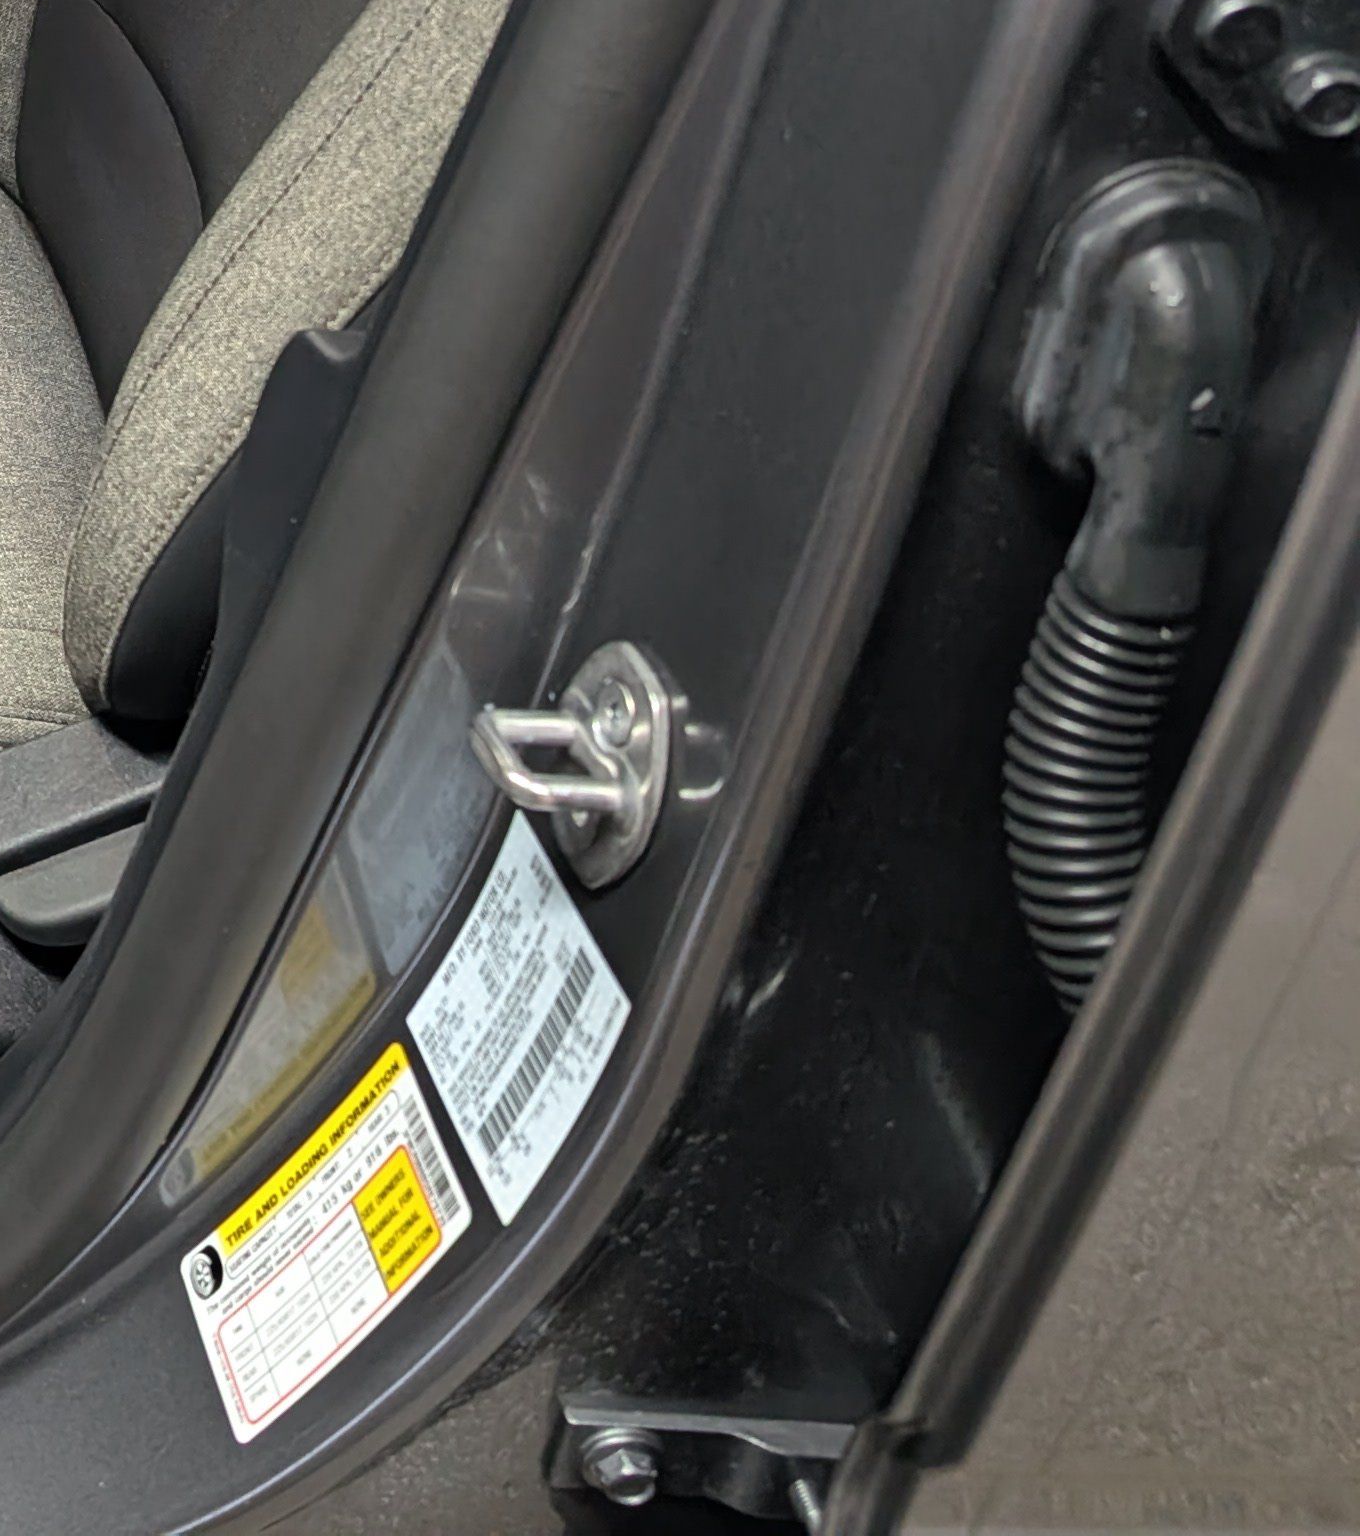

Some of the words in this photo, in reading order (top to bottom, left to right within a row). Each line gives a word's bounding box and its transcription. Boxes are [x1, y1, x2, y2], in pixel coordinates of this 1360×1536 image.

[225, 1217, 254, 1247] TIRE
[255, 1194, 279, 1222] AND
[280, 1145, 329, 1197] LOADING
[330, 1060, 401, 1146] INFORMATION
[321, 1194, 339, 1214] 415
[340, 1180, 354, 1197] kg
[353, 1169, 363, 1182] or
[368, 1205, 400, 1240] MANUAL
[398, 1186, 414, 1206] FOR
[379, 1209, 421, 1258] ADDITIONAL
